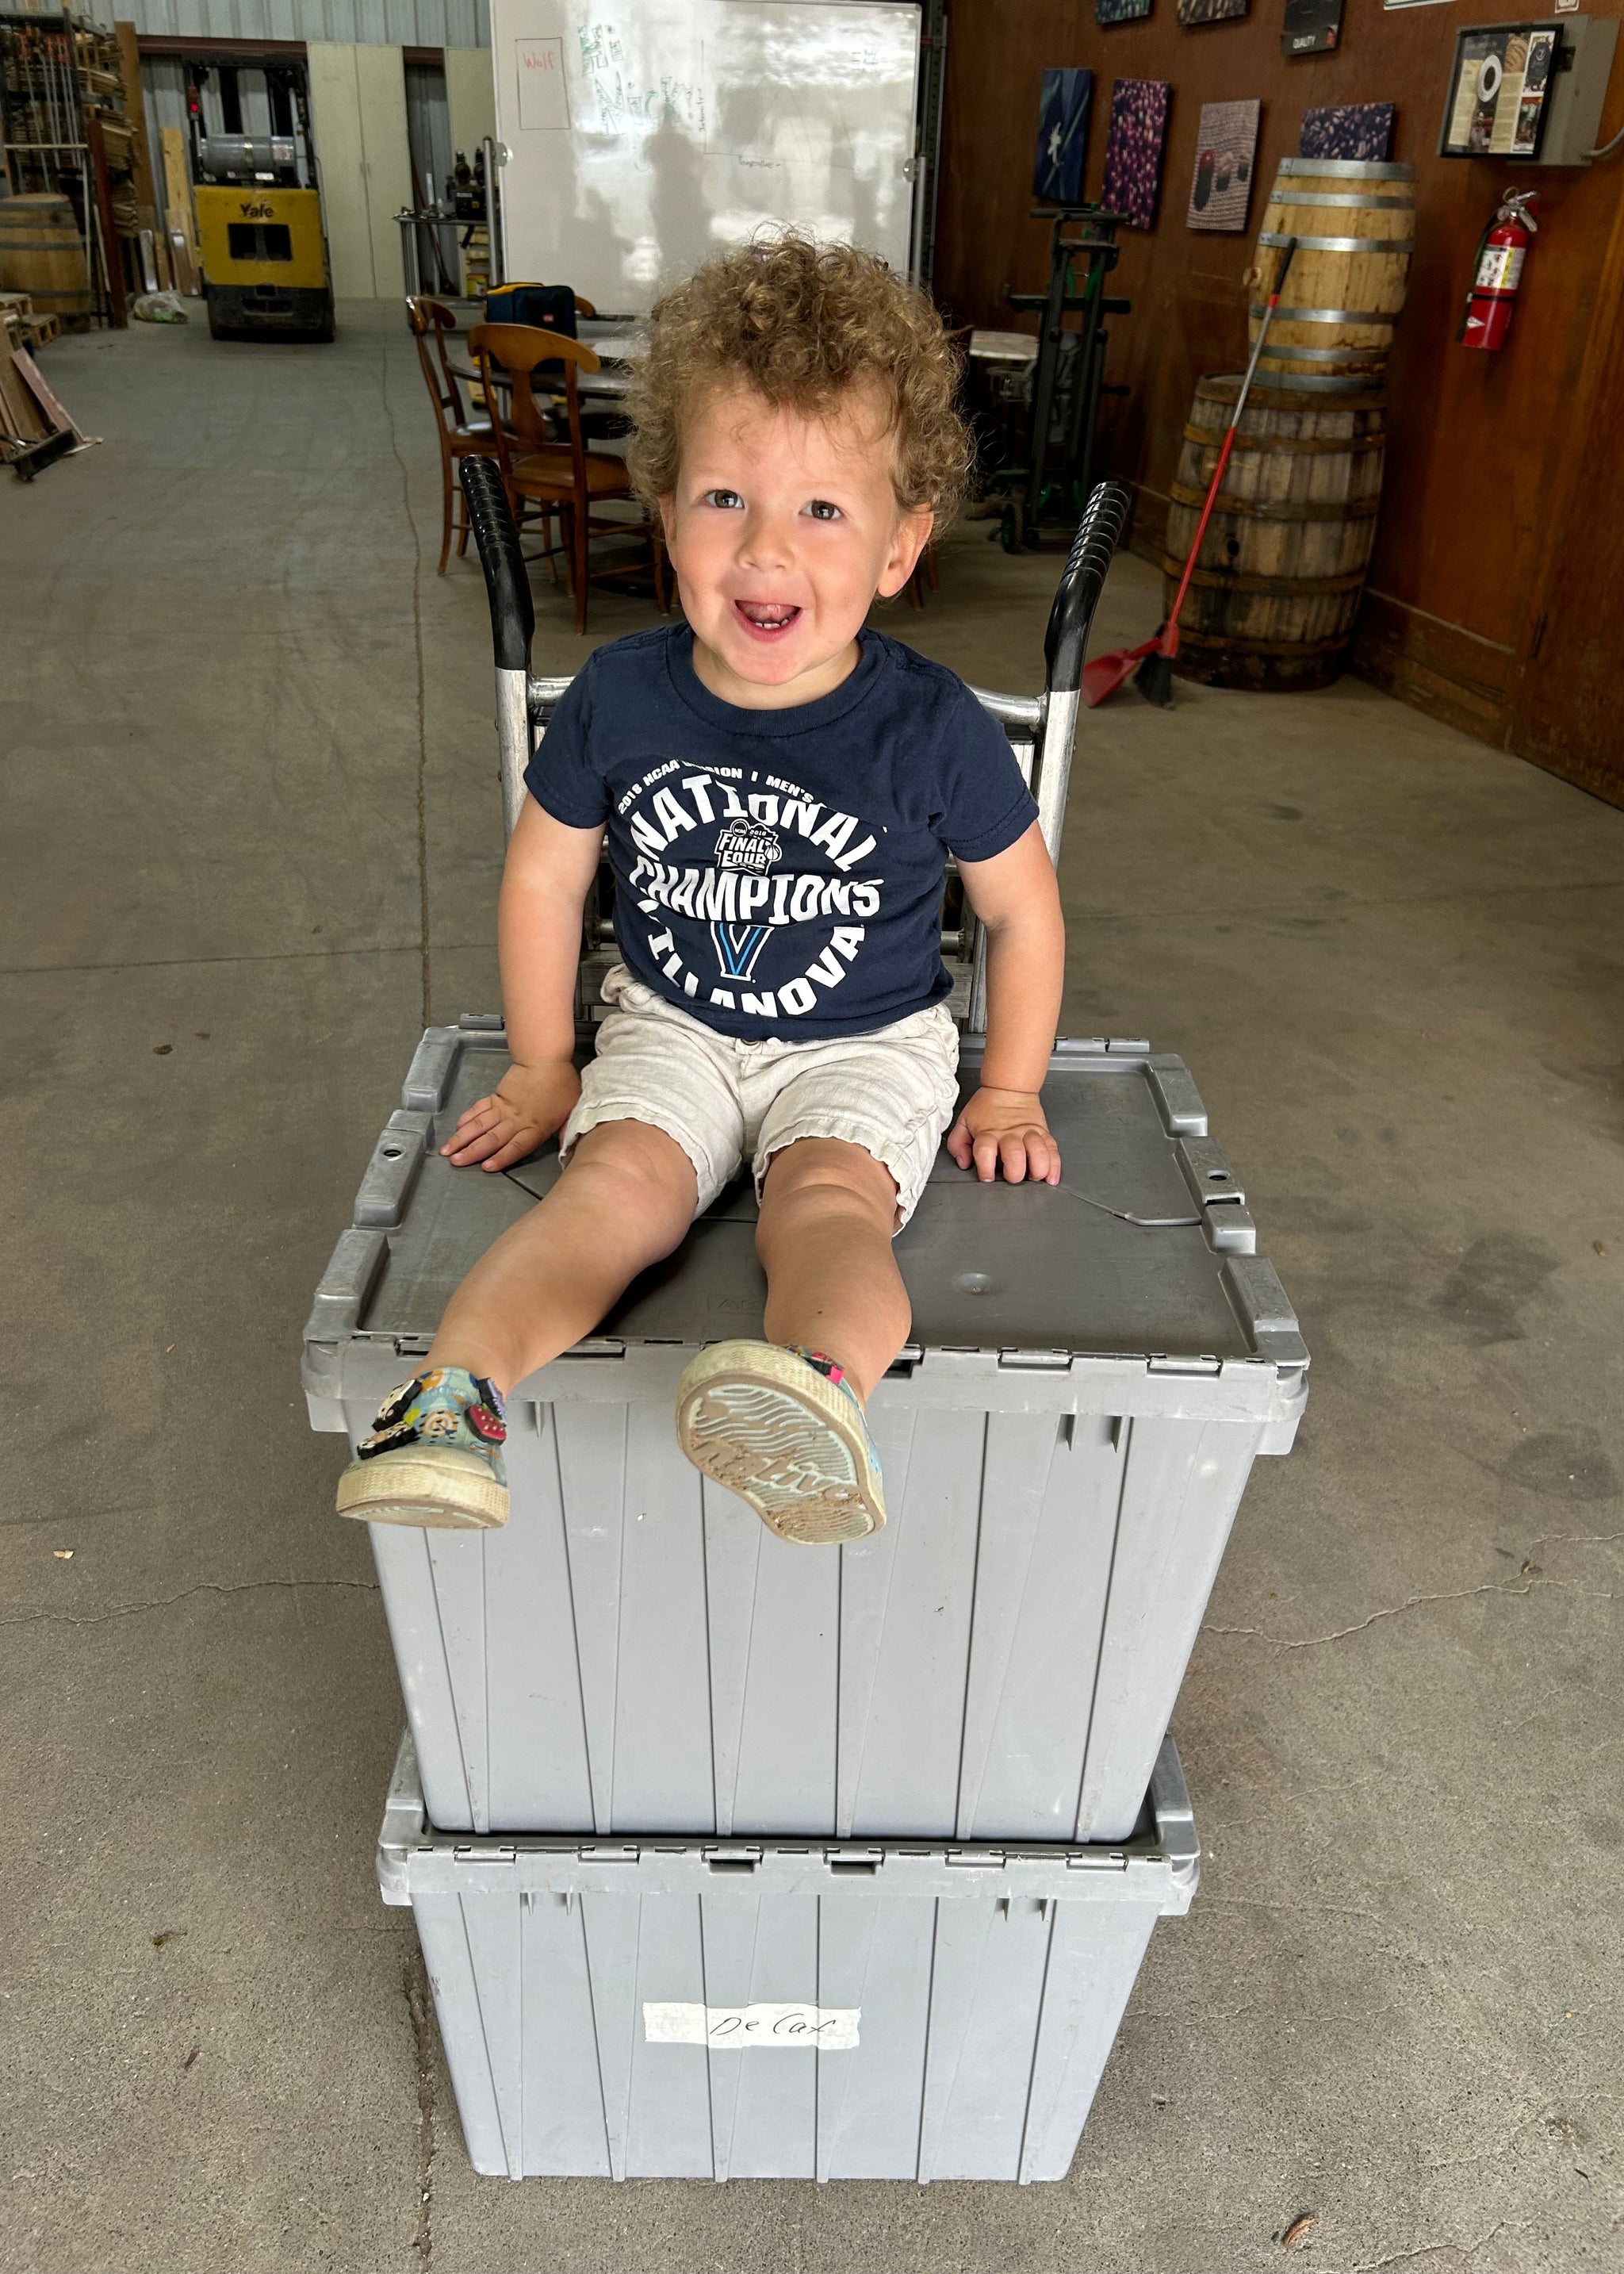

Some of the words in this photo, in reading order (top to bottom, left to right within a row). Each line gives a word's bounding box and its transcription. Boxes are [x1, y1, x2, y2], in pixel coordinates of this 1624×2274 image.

[1293, 35, 1316, 49] QUALITY
[240, 203, 275, 218] Yale
[618, 783, 643, 815] 2018
[642, 759, 680, 787] NCAA
[765, 775, 814, 803] MEN'S
[630, 774, 877, 872] NATIONAL
[718, 832, 766, 853] FINAL
[721, 849, 767, 867] FOUR
[629, 855, 885, 925] CHAMPIONS
[709, 2016, 760, 2036] De
